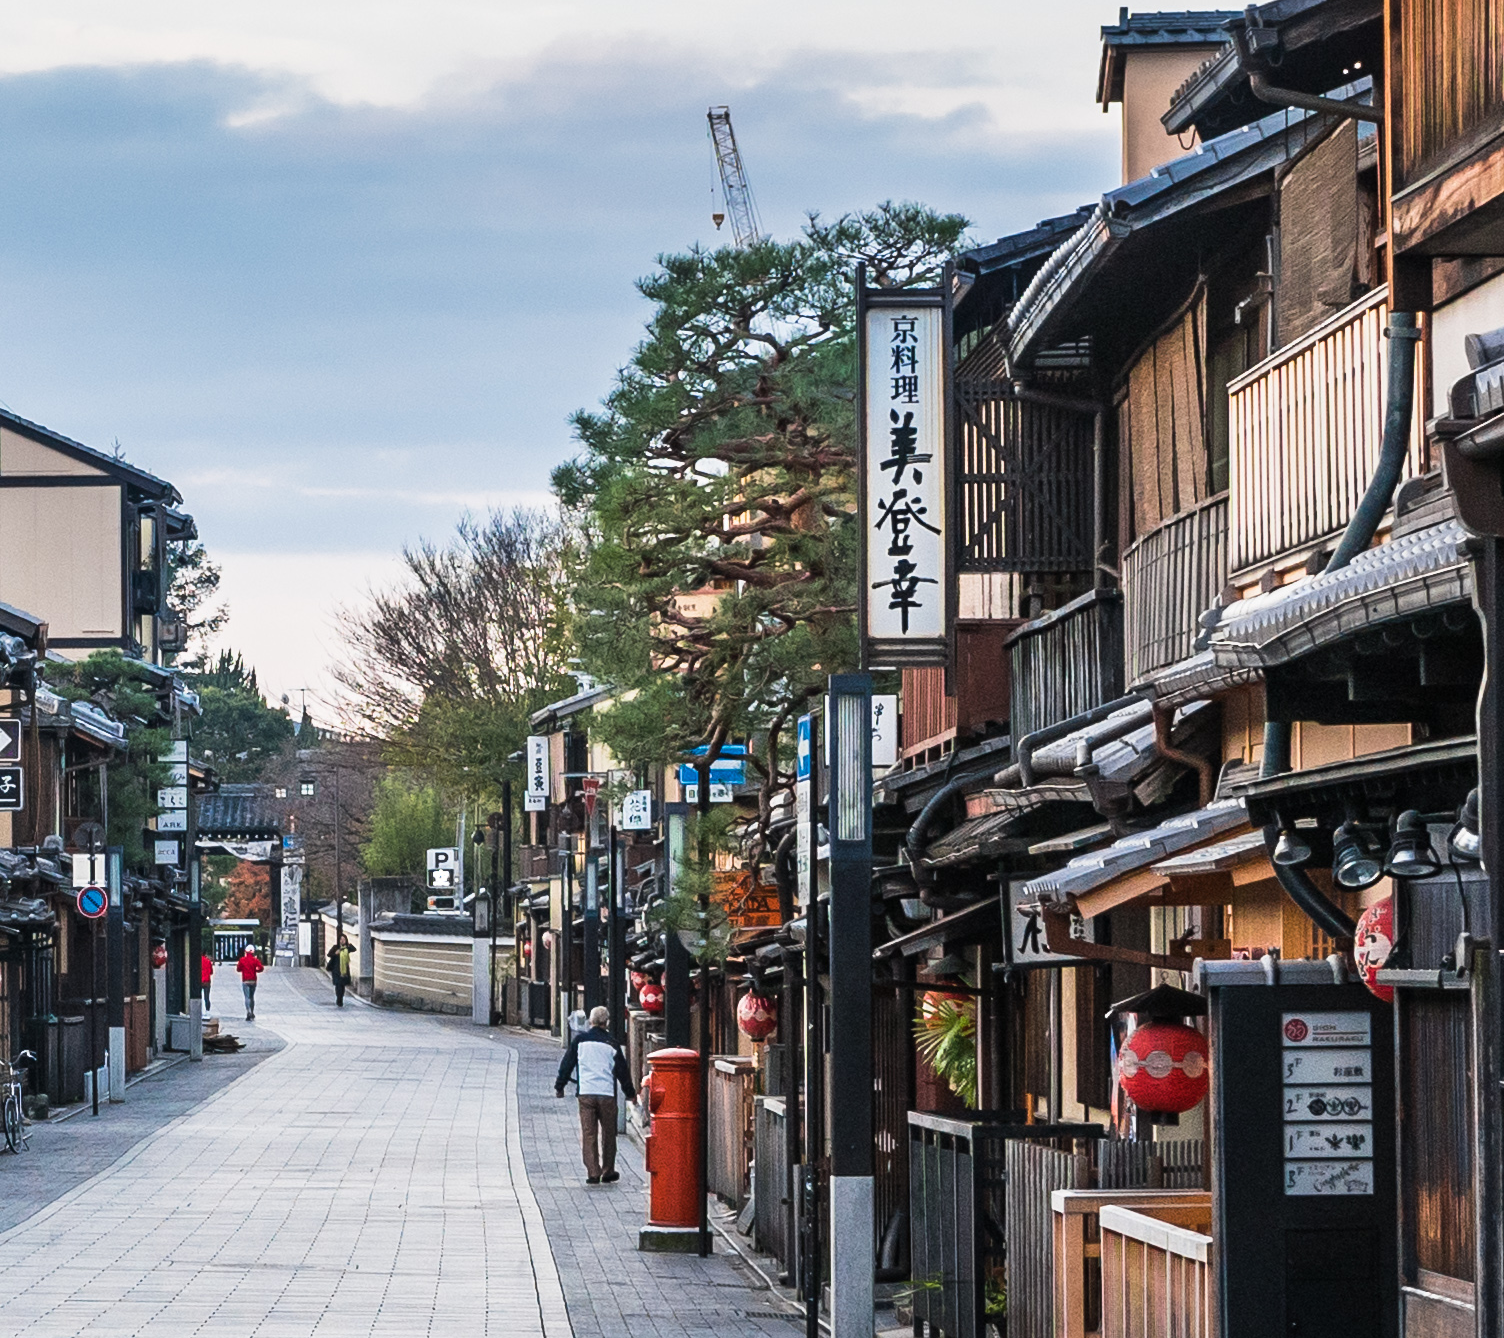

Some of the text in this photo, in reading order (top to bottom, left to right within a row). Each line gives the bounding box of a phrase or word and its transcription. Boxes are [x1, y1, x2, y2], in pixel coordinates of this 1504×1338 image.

[890, 314, 920, 404] 京料理
[434, 851, 450, 868] P
